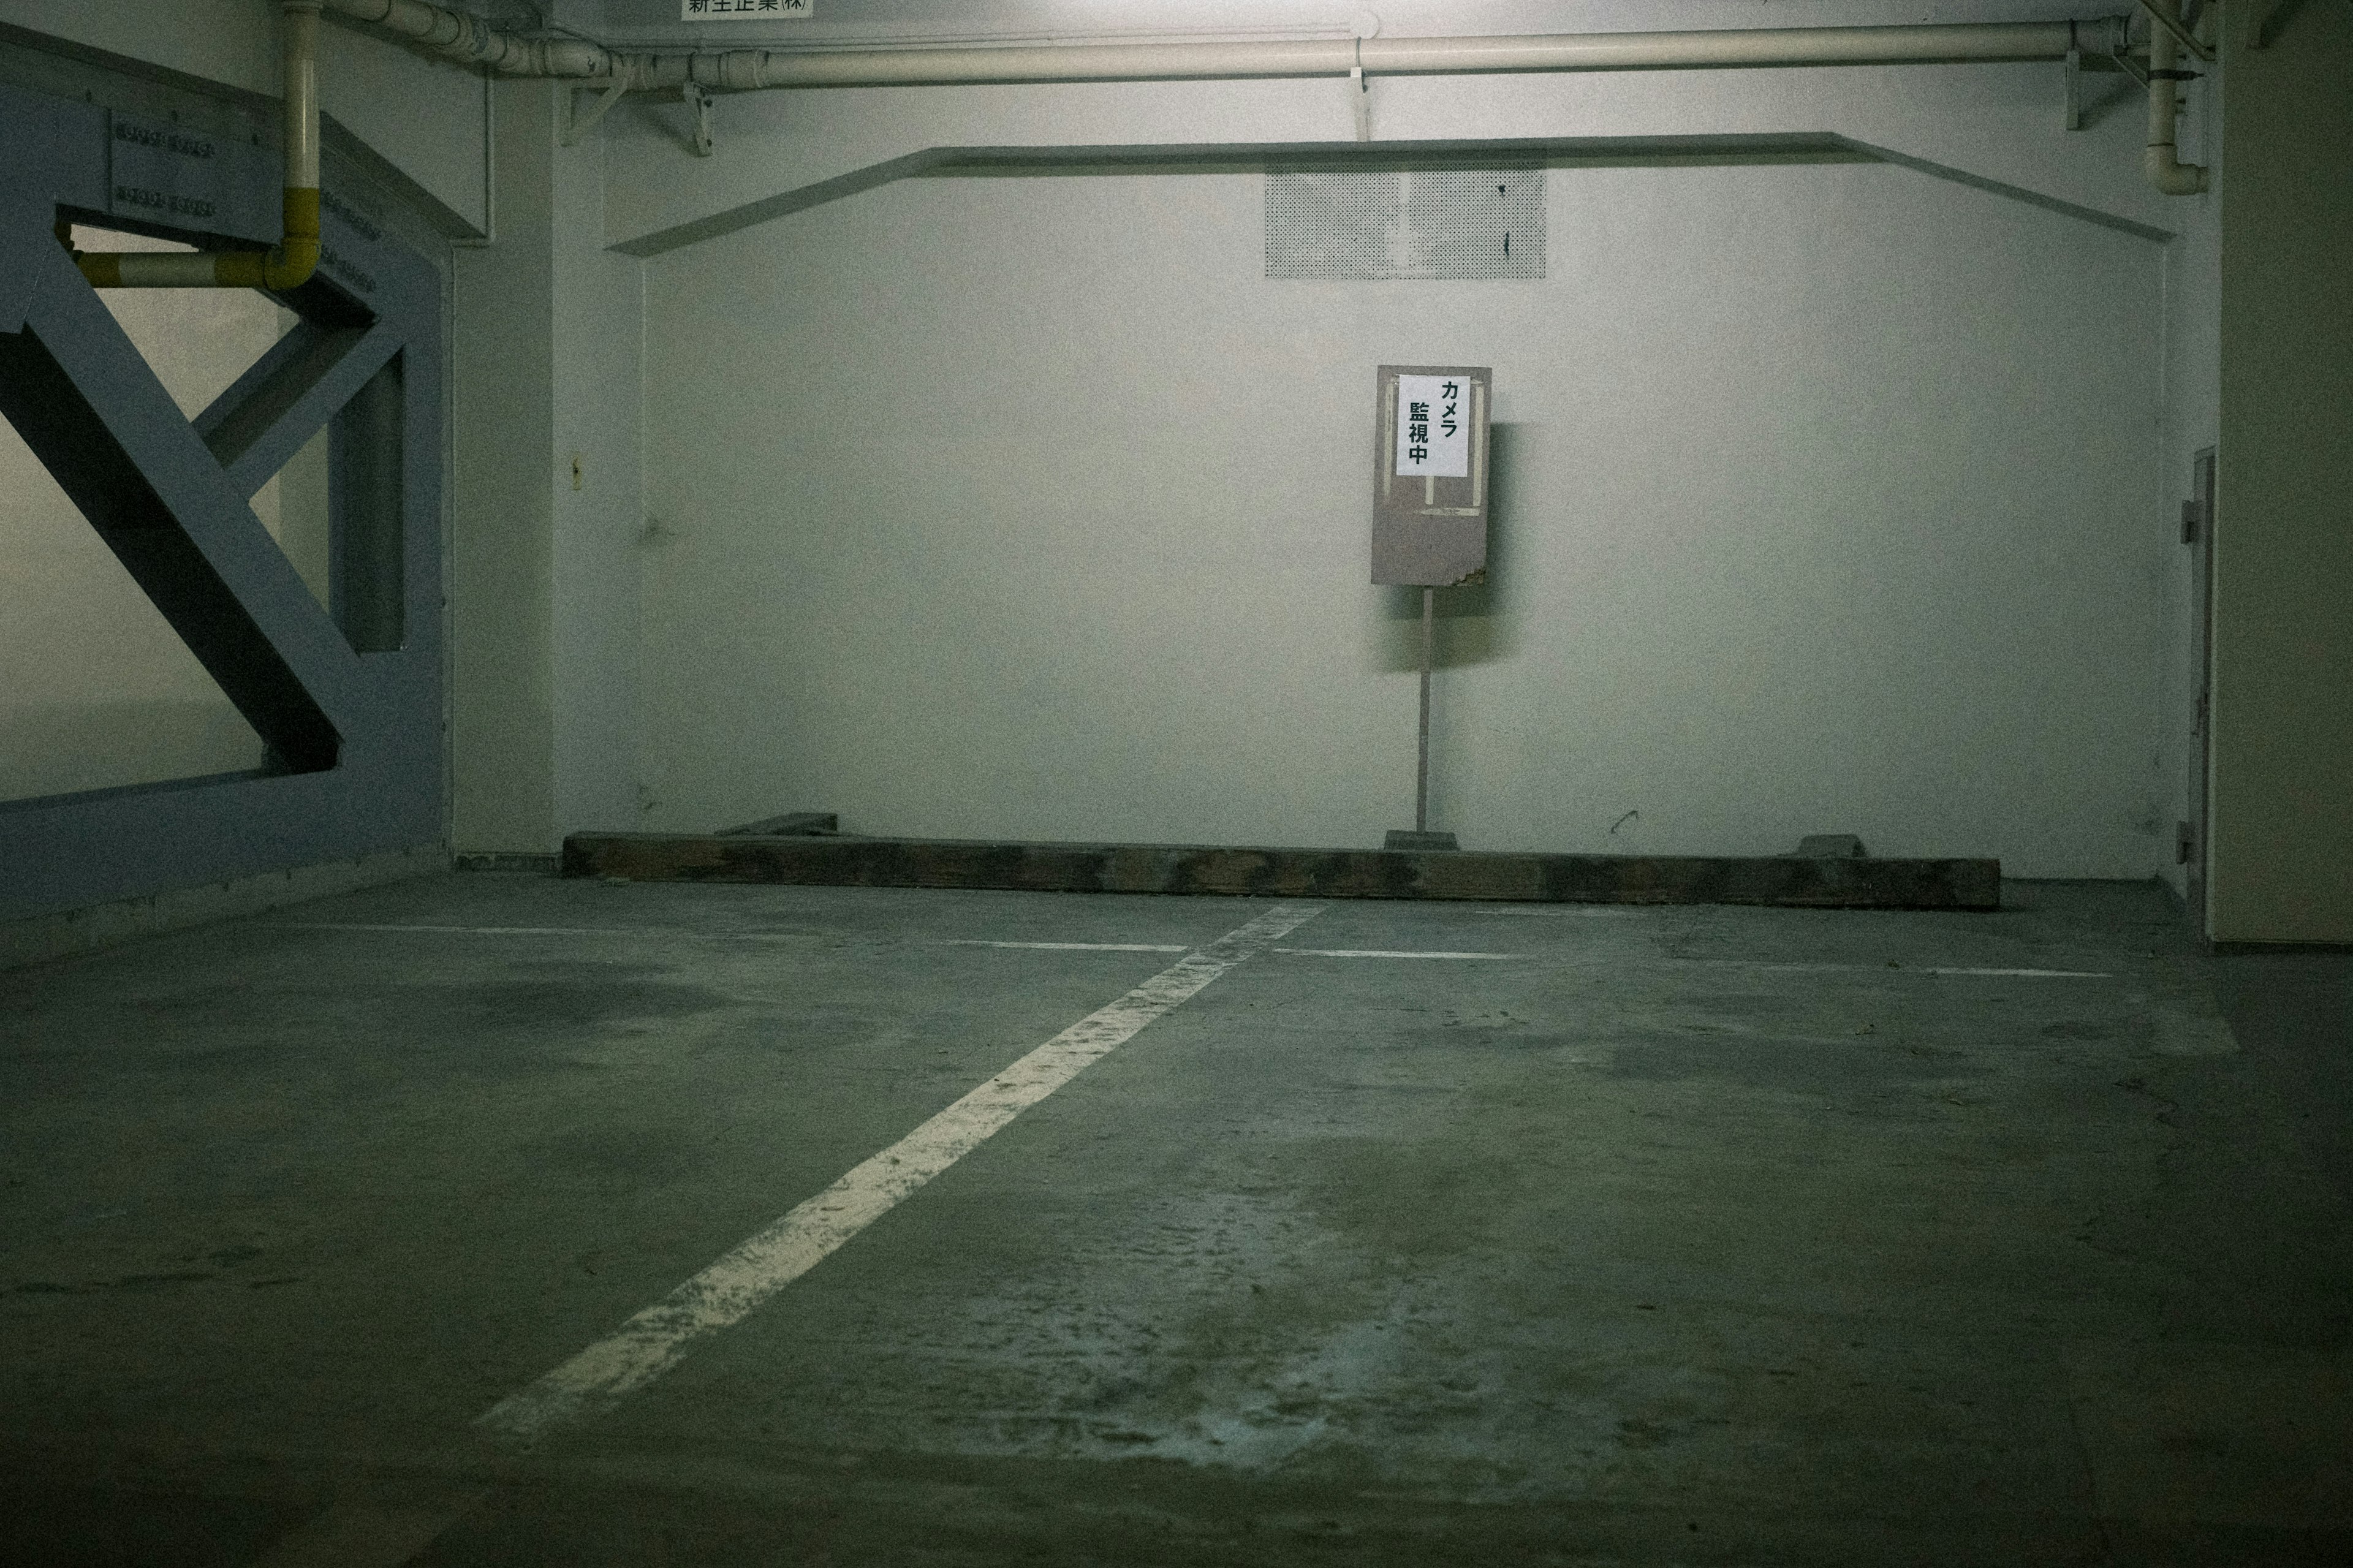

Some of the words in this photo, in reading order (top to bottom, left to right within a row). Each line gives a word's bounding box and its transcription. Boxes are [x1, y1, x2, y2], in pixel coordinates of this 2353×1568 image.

[1409, 402, 1430, 464] 監視中
[1441, 381, 1458, 437] カメラ
